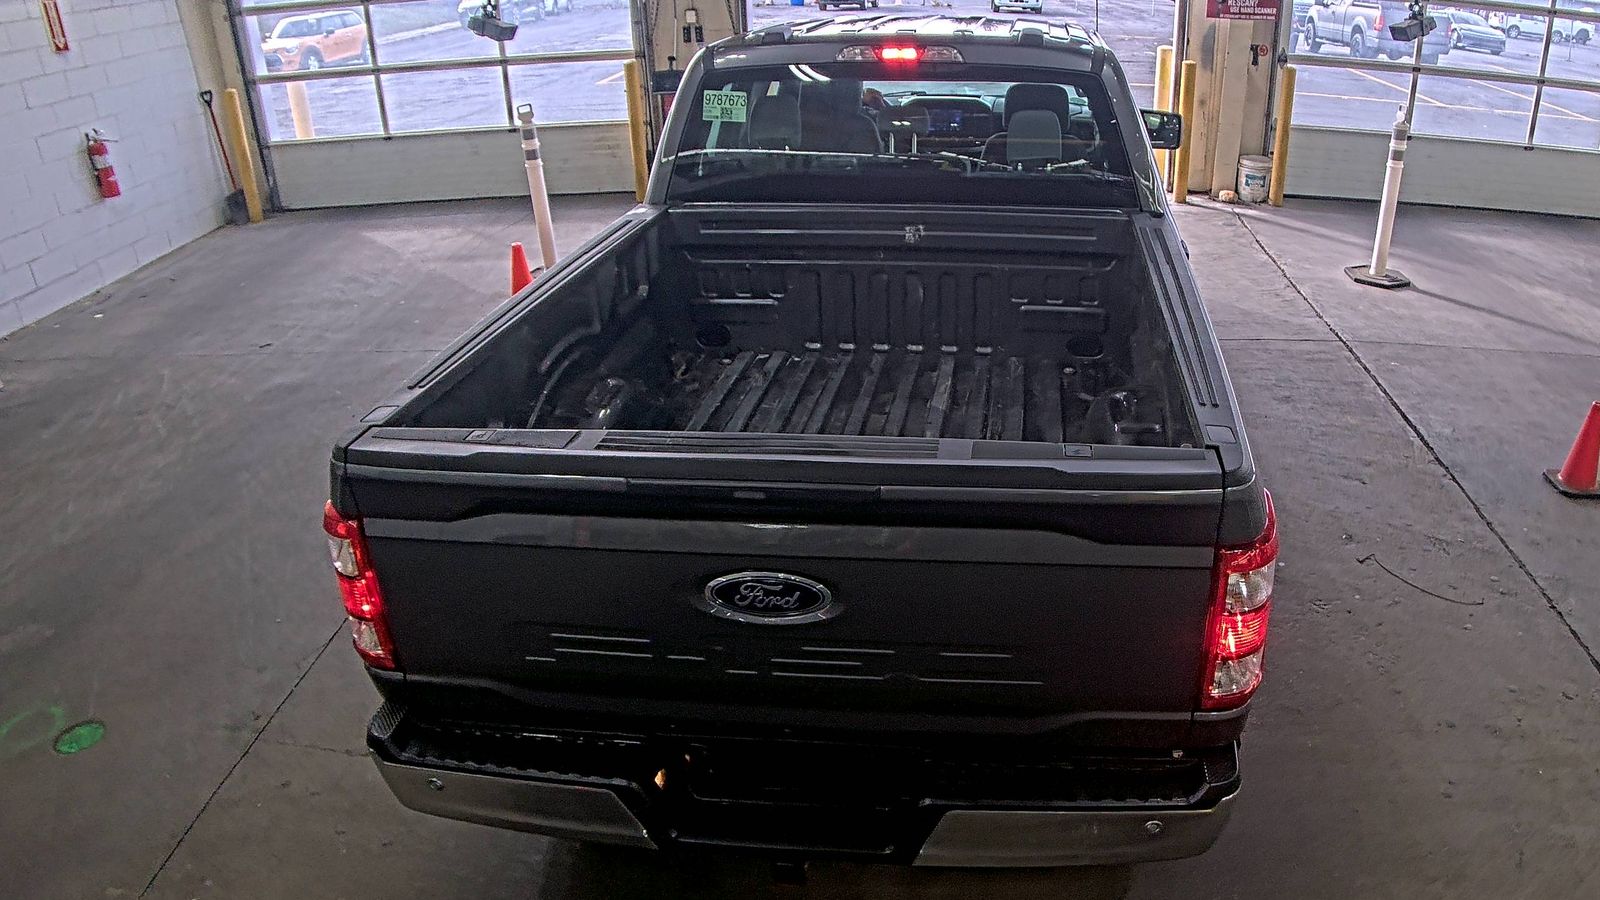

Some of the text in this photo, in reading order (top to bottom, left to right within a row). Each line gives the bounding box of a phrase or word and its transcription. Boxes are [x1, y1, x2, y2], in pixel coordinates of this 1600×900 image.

[1254, 7, 1277, 15] SCANNER
[704, 93, 747, 107] 9787673
[734, 582, 801, 609] Ford
